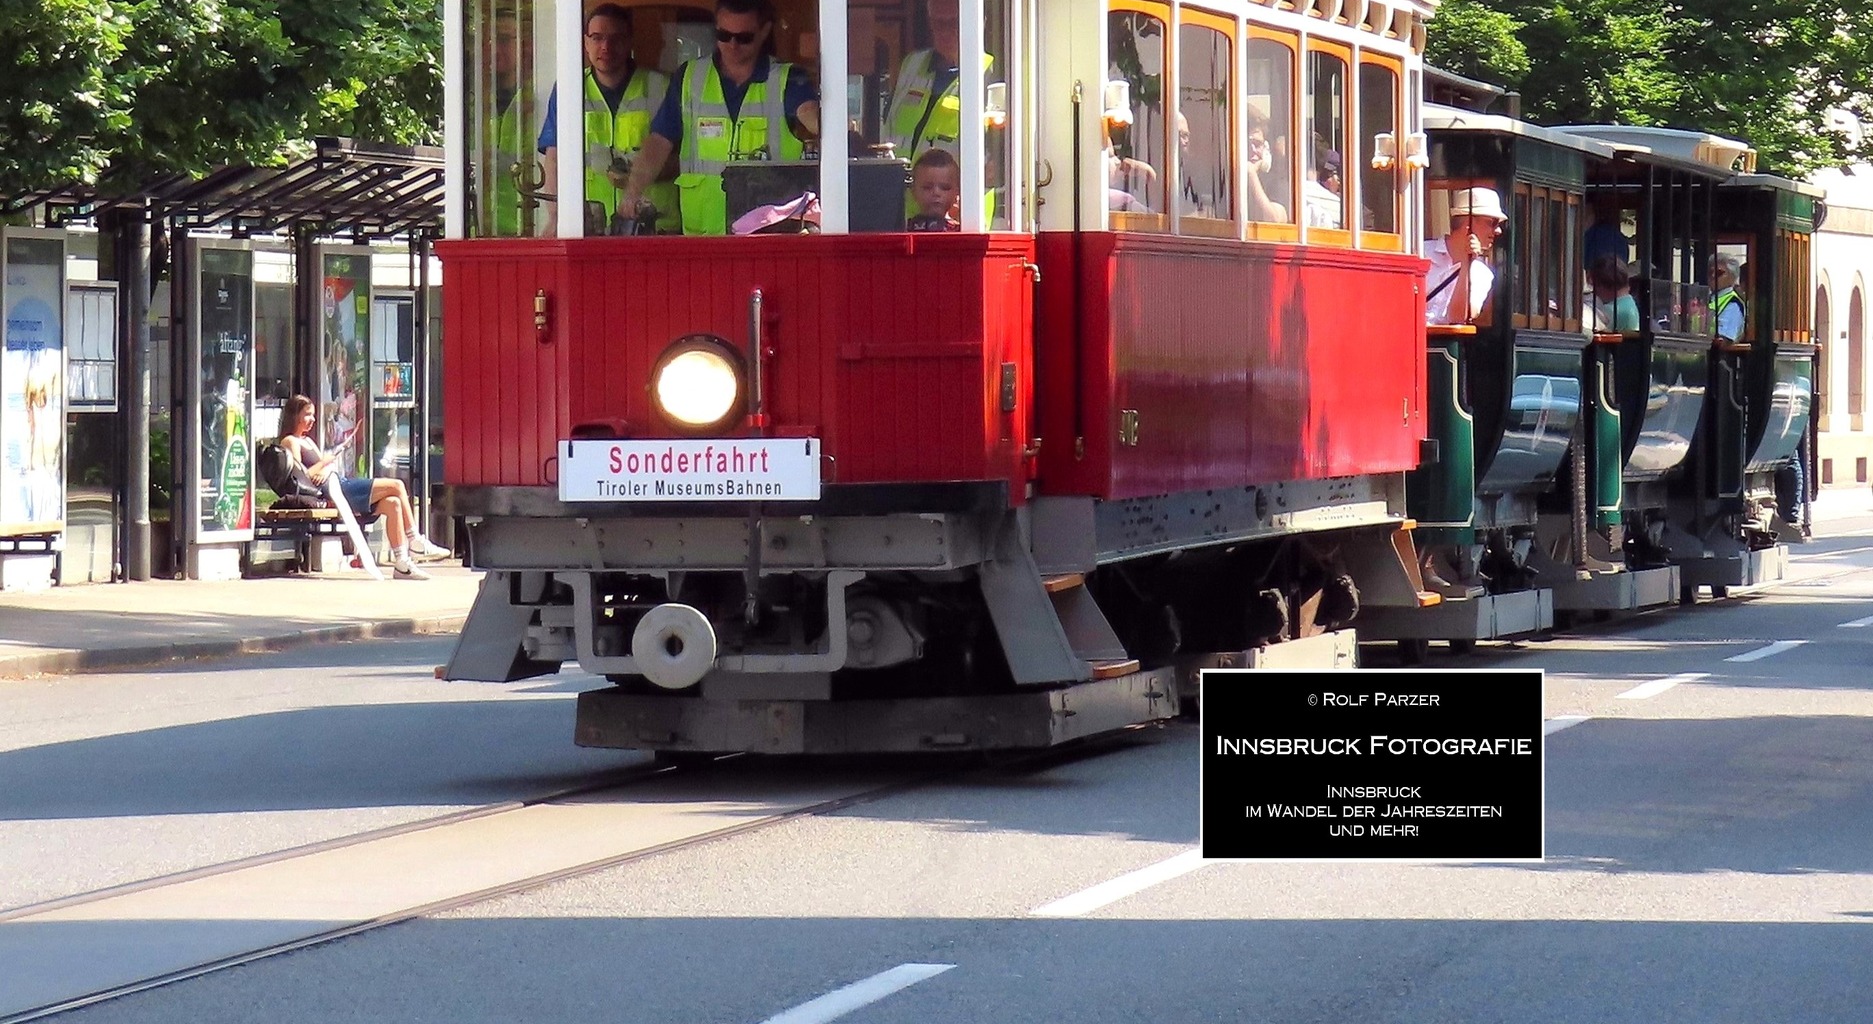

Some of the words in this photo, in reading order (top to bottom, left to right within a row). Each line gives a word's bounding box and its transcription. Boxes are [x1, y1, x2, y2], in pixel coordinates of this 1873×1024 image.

[609, 446, 769, 474] Sonderfahrt
[597, 480, 648, 496] Tiroler
[655, 480, 782, 496] MuseumsBahnen
